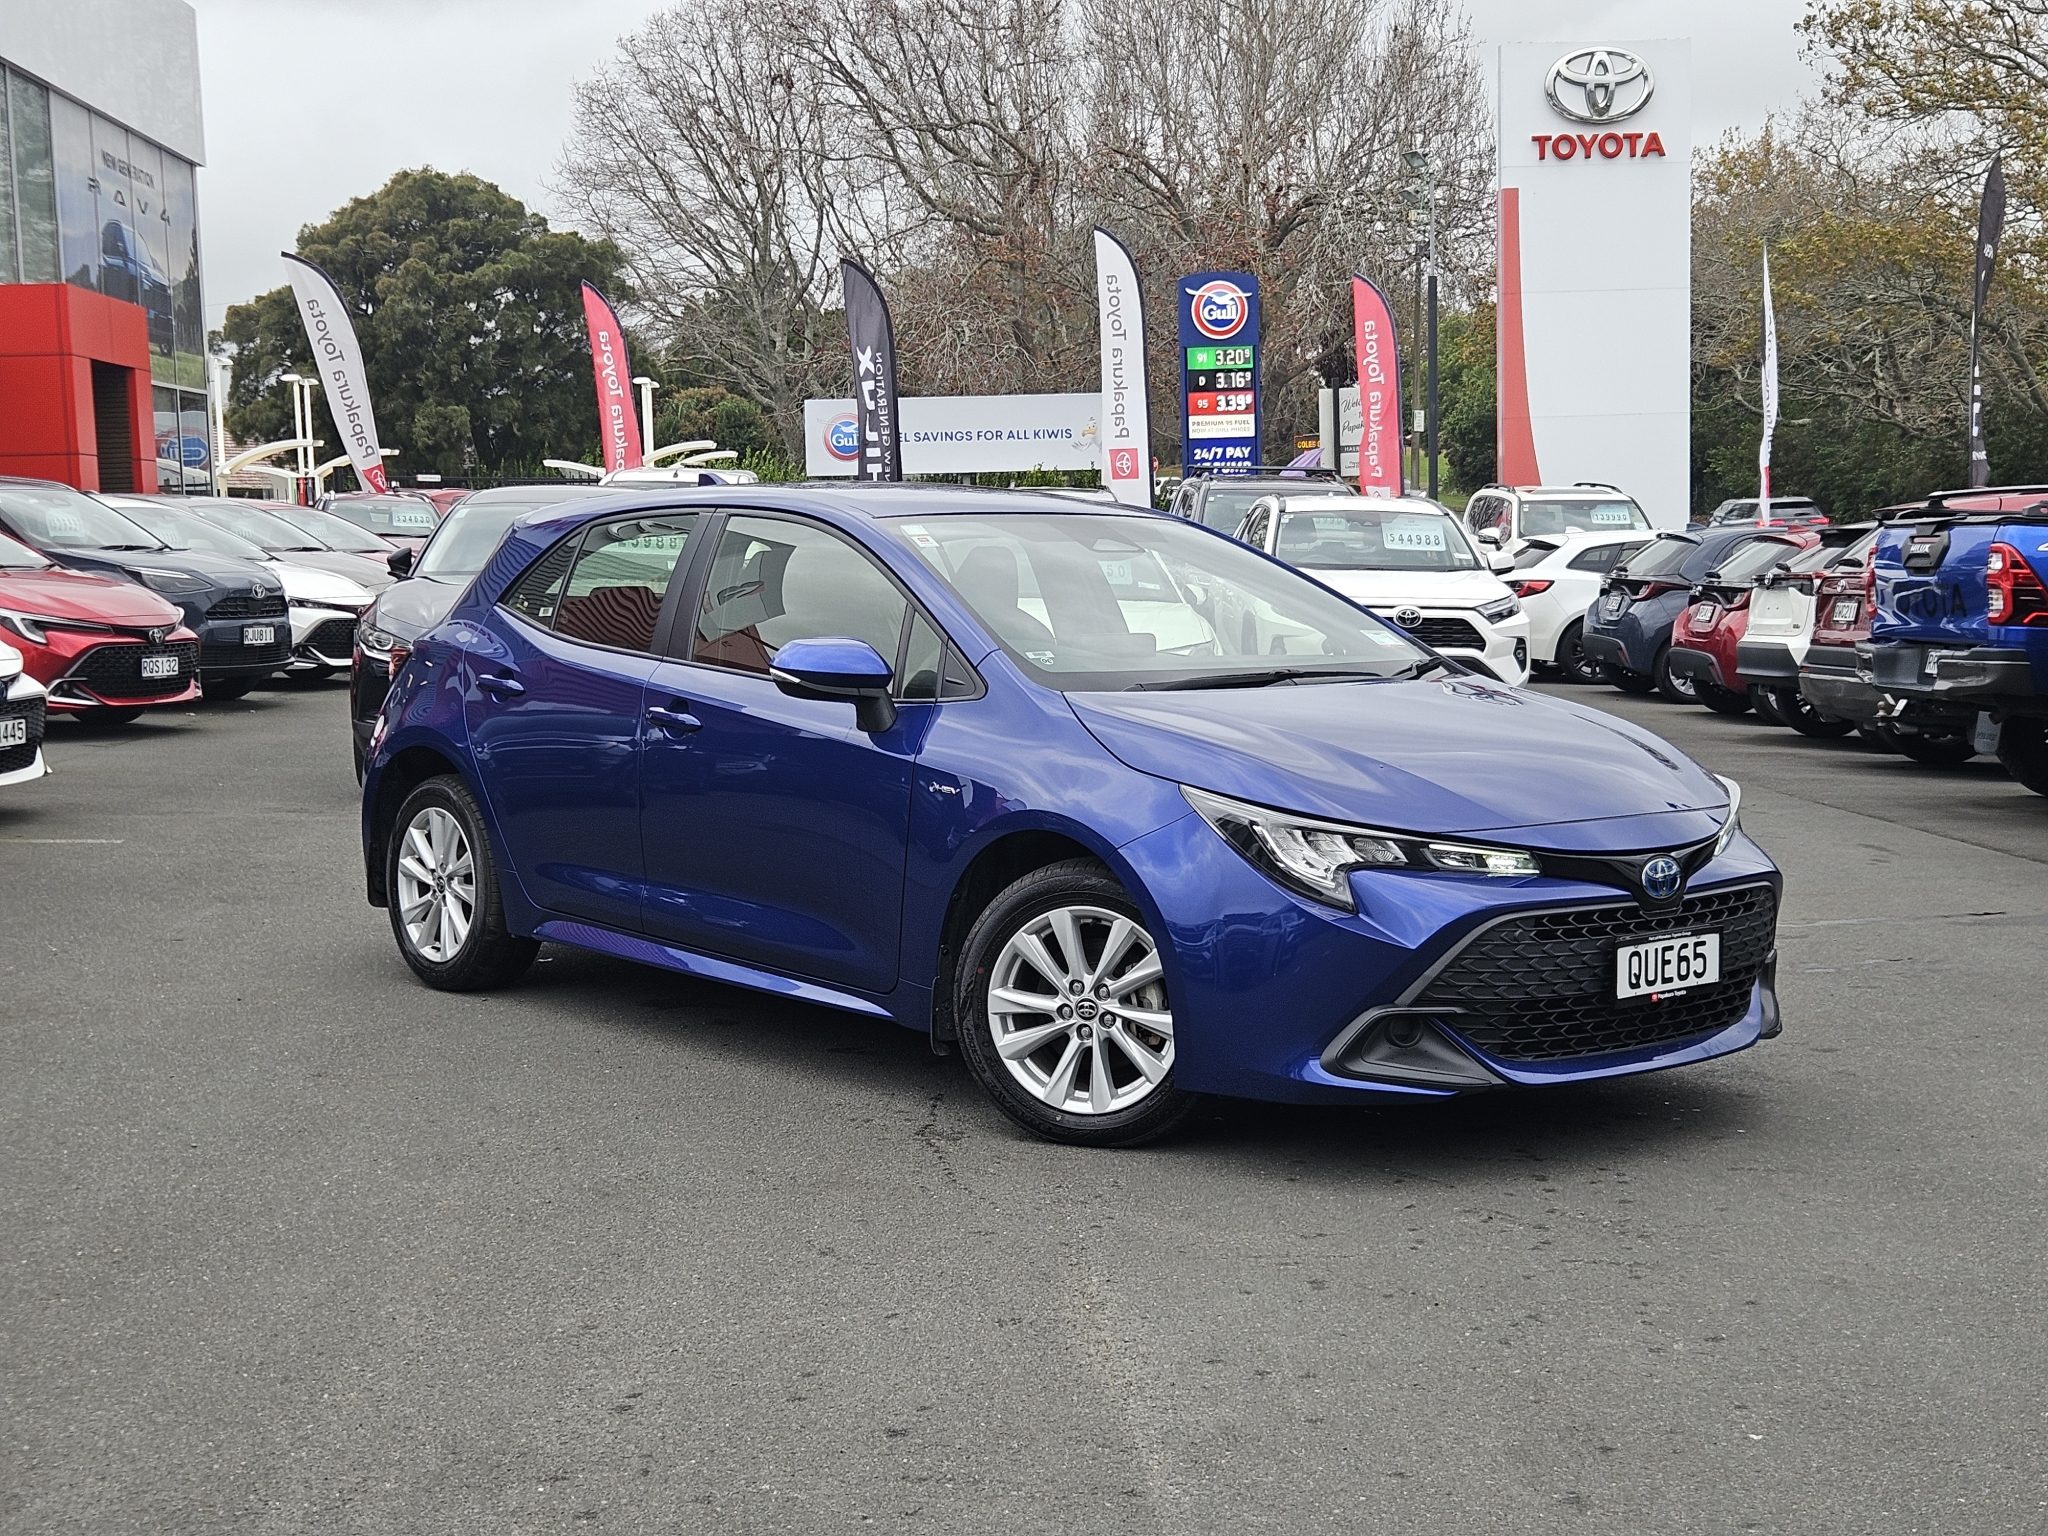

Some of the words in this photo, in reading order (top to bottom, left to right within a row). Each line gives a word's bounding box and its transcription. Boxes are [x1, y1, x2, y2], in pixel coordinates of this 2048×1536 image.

[1531, 132, 1666, 160] TOYOTA
[1203, 304, 1237, 320] Gull
[1197, 352, 1207, 363] 91
[1198, 376, 1206, 386] D
[1197, 399, 1208, 408] 95
[831, 434, 859, 446] Gul
[913, 430, 973, 442] SAVINGS
[976, 430, 1003, 441] FOR
[1007, 429, 1030, 440] ALL
[1033, 428, 1073, 440] KIWIS
[1193, 447, 1224, 460] 24/7
[1225, 446, 1251, 458] PAY
[142, 658, 177, 674] RQS132
[0, 721, 24, 742] 445
[1628, 940, 1707, 990] QUE65
